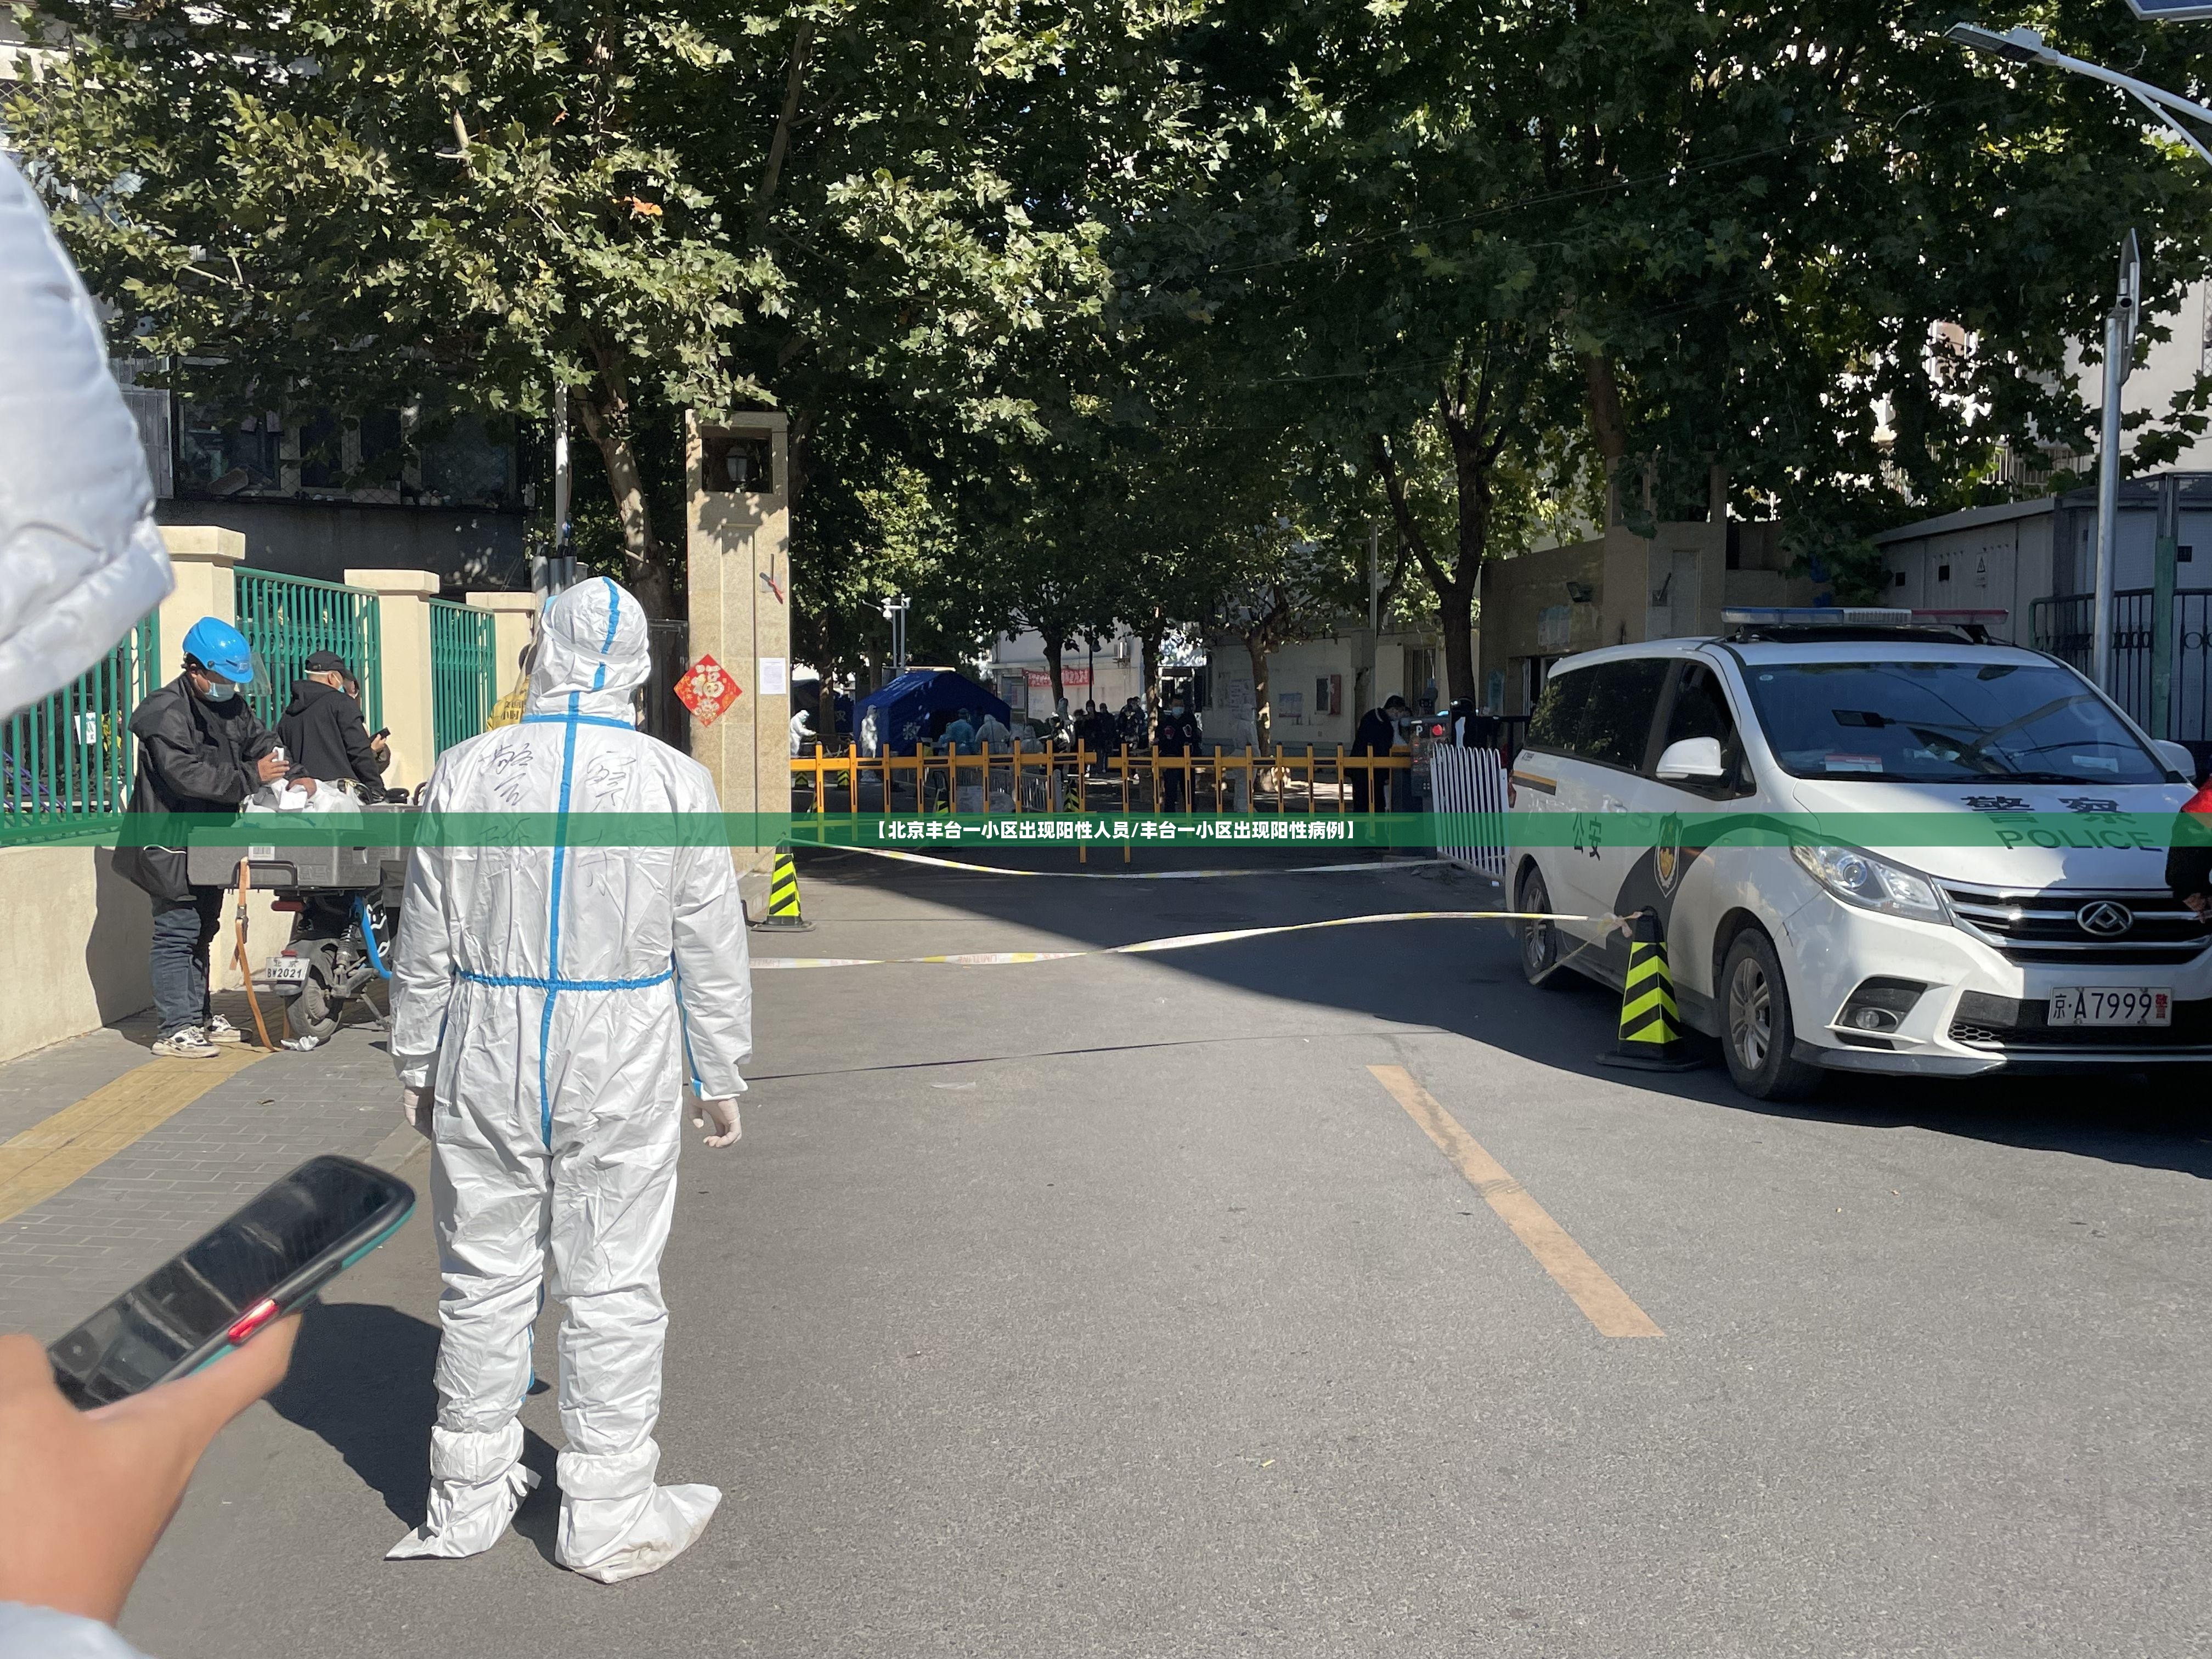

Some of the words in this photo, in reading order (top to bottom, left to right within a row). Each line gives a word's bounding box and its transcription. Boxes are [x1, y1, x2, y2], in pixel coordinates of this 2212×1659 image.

[691, 664, 725, 698] 福
[1961, 796, 2137, 824] 警察
[1572, 812, 1602, 861] 公安
[1995, 830, 2163, 852] POLICE
